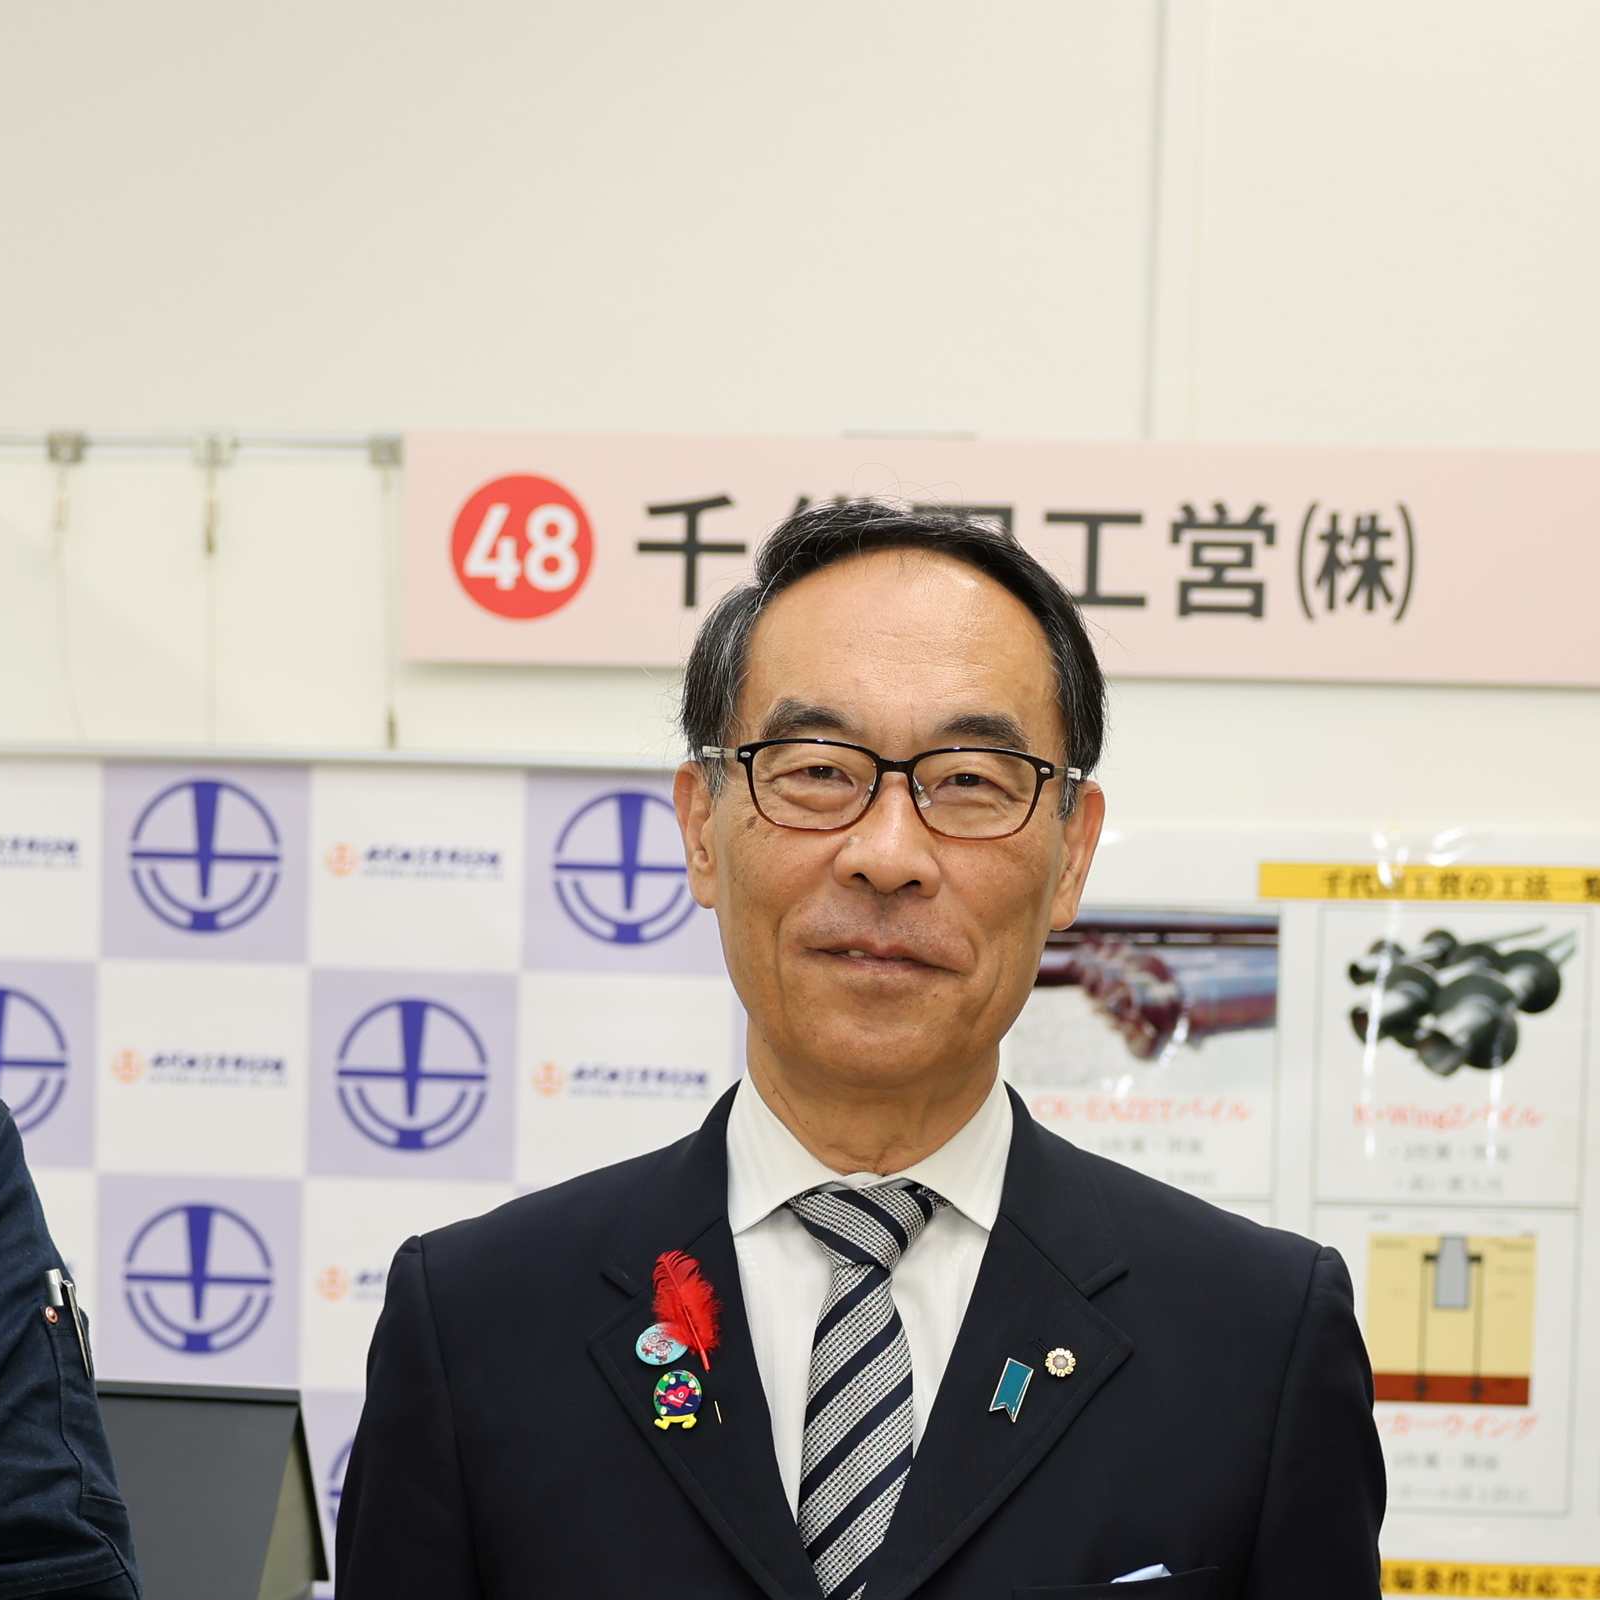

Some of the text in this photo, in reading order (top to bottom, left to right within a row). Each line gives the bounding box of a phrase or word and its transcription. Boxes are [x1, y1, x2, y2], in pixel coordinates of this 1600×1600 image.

[463, 494, 1417, 623] 48 千工営(株)
